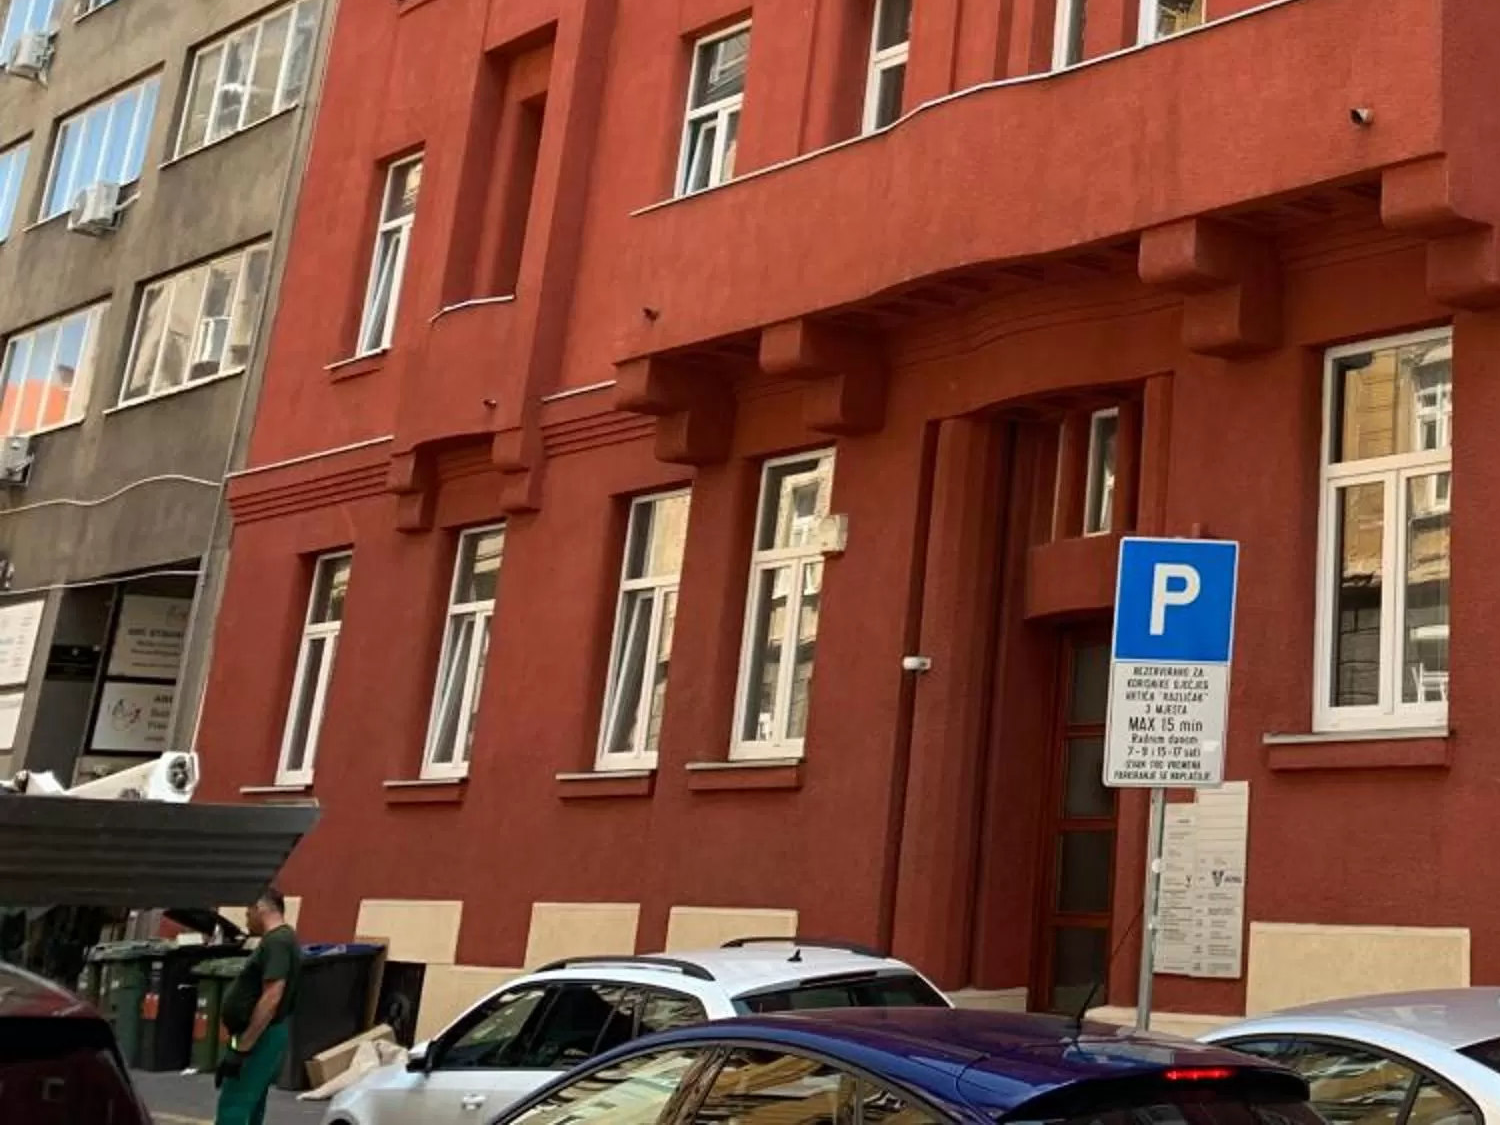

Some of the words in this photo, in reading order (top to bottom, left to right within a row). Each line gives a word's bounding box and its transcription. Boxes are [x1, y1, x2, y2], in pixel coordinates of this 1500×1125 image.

[1149, 562, 1201, 636] P
[1192, 666, 1204, 677] ZA
[1155, 704, 1188, 716] MJESTA
[1128, 716, 1156, 732] MAX
[1161, 717, 1175, 732] 15
[1179, 718, 1203, 732] min
